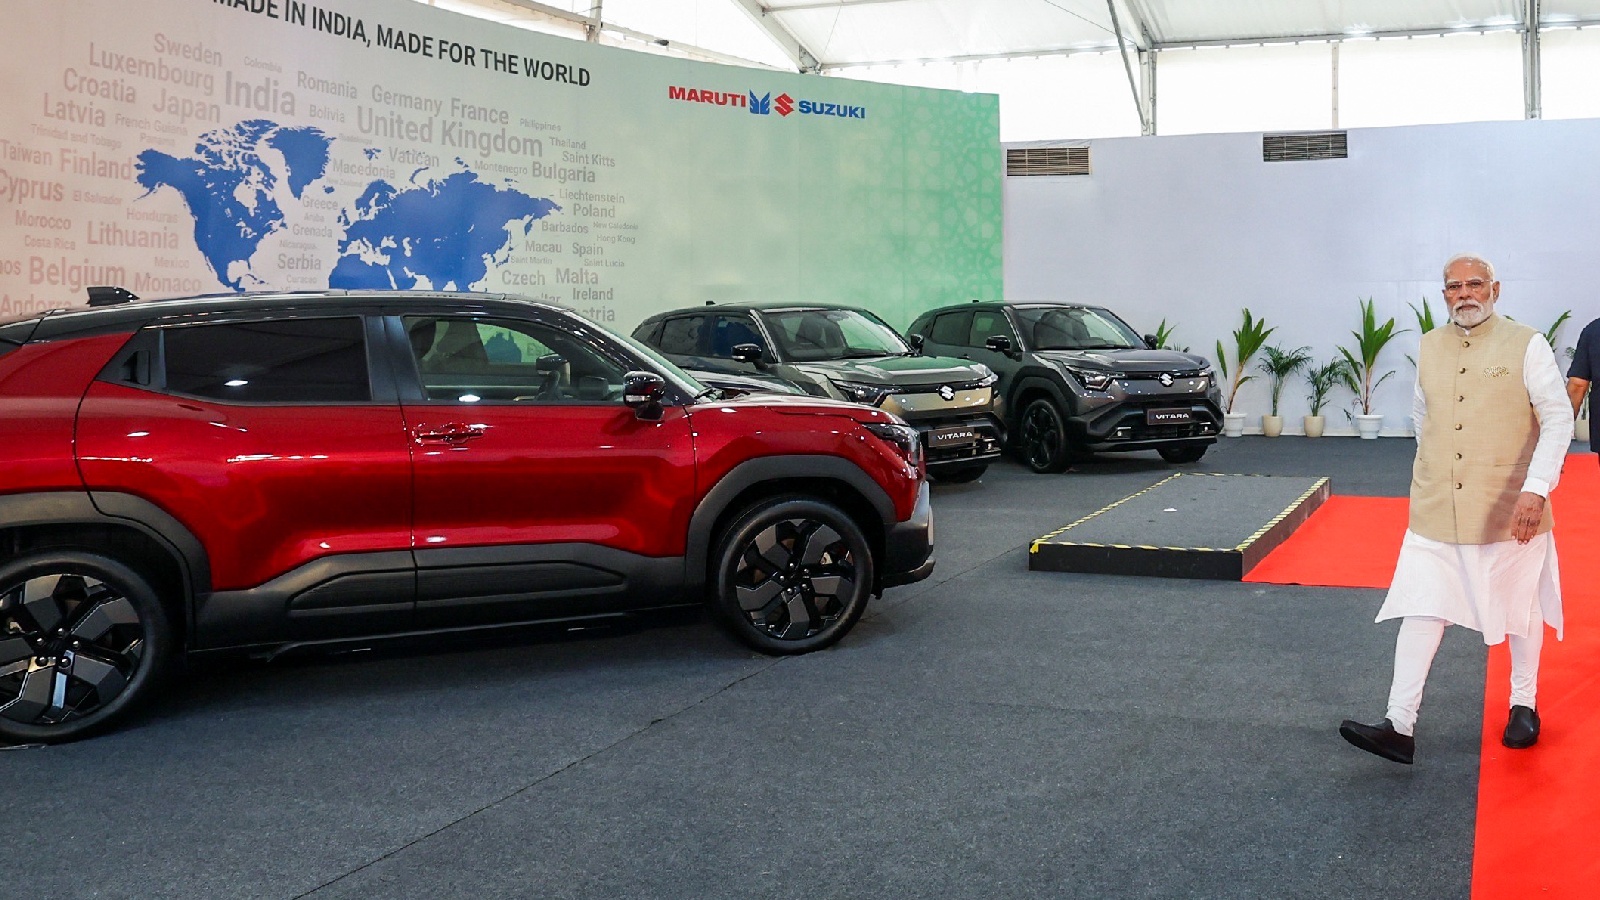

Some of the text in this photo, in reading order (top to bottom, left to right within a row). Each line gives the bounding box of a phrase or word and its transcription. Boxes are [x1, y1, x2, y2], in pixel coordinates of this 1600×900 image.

[154, 33, 223, 67] Sweden
[285, 0, 306, 26] IN
[312, 6, 371, 48] INDIA,
[377, 24, 434, 58] MADE
[439, 39, 476, 67] FOR
[480, 49, 519, 75] THE
[524, 57, 591, 87] WORLD
[89, 42, 214, 96] Luxembourg
[244, 56, 283, 73] Colombia
[63, 68, 136, 104] Croatia
[225, 71, 296, 116] India
[297, 70, 358, 100] Romania
[152, 88, 221, 124] Japan
[372, 84, 443, 117] Germany
[669, 86, 866, 119] MARUTI SUZUKI
[43, 93, 106, 127] Latvia
[309, 104, 345, 123] Bolivia
[451, 97, 510, 125] France
[115, 113, 151, 130] French
[520, 118, 562, 132] Philippines
[357, 106, 544, 158] United Kingdom
[0, 139, 52, 165] Taiwan
[548, 136, 586, 150] Thailand
[60, 148, 132, 180] Finland
[388, 146, 440, 168] Vatican
[562, 150, 616, 168] Saint Kitts
[333, 158, 396, 179] Macedonia
[474, 160, 528, 176] Montenegro
[532, 161, 596, 184] Bulgaria
[303, 195, 339, 210] Greece
[560, 189, 625, 203] Liechtenstein
[15, 209, 72, 230] Morocco
[126, 208, 178, 224] Honduras
[573, 203, 616, 218] Poland
[87, 220, 179, 250] Lithuania
[292, 223, 333, 238] Grenada
[541, 221, 589, 234] Barbados
[24, 234, 76, 251] Costa Rica
[525, 240, 562, 253] Macau
[596, 235, 636, 244] Hong Kong
[572, 242, 604, 258] Spain
[154, 256, 190, 270] Mexico
[278, 253, 321, 270] Serbia
[29, 255, 125, 294] Belgium
[134, 272, 201, 293] Monaco
[501, 269, 546, 286] Czech
[556, 267, 599, 285] Malta
[573, 287, 614, 300] Ireland
[937, 431, 973, 440] VITARA
